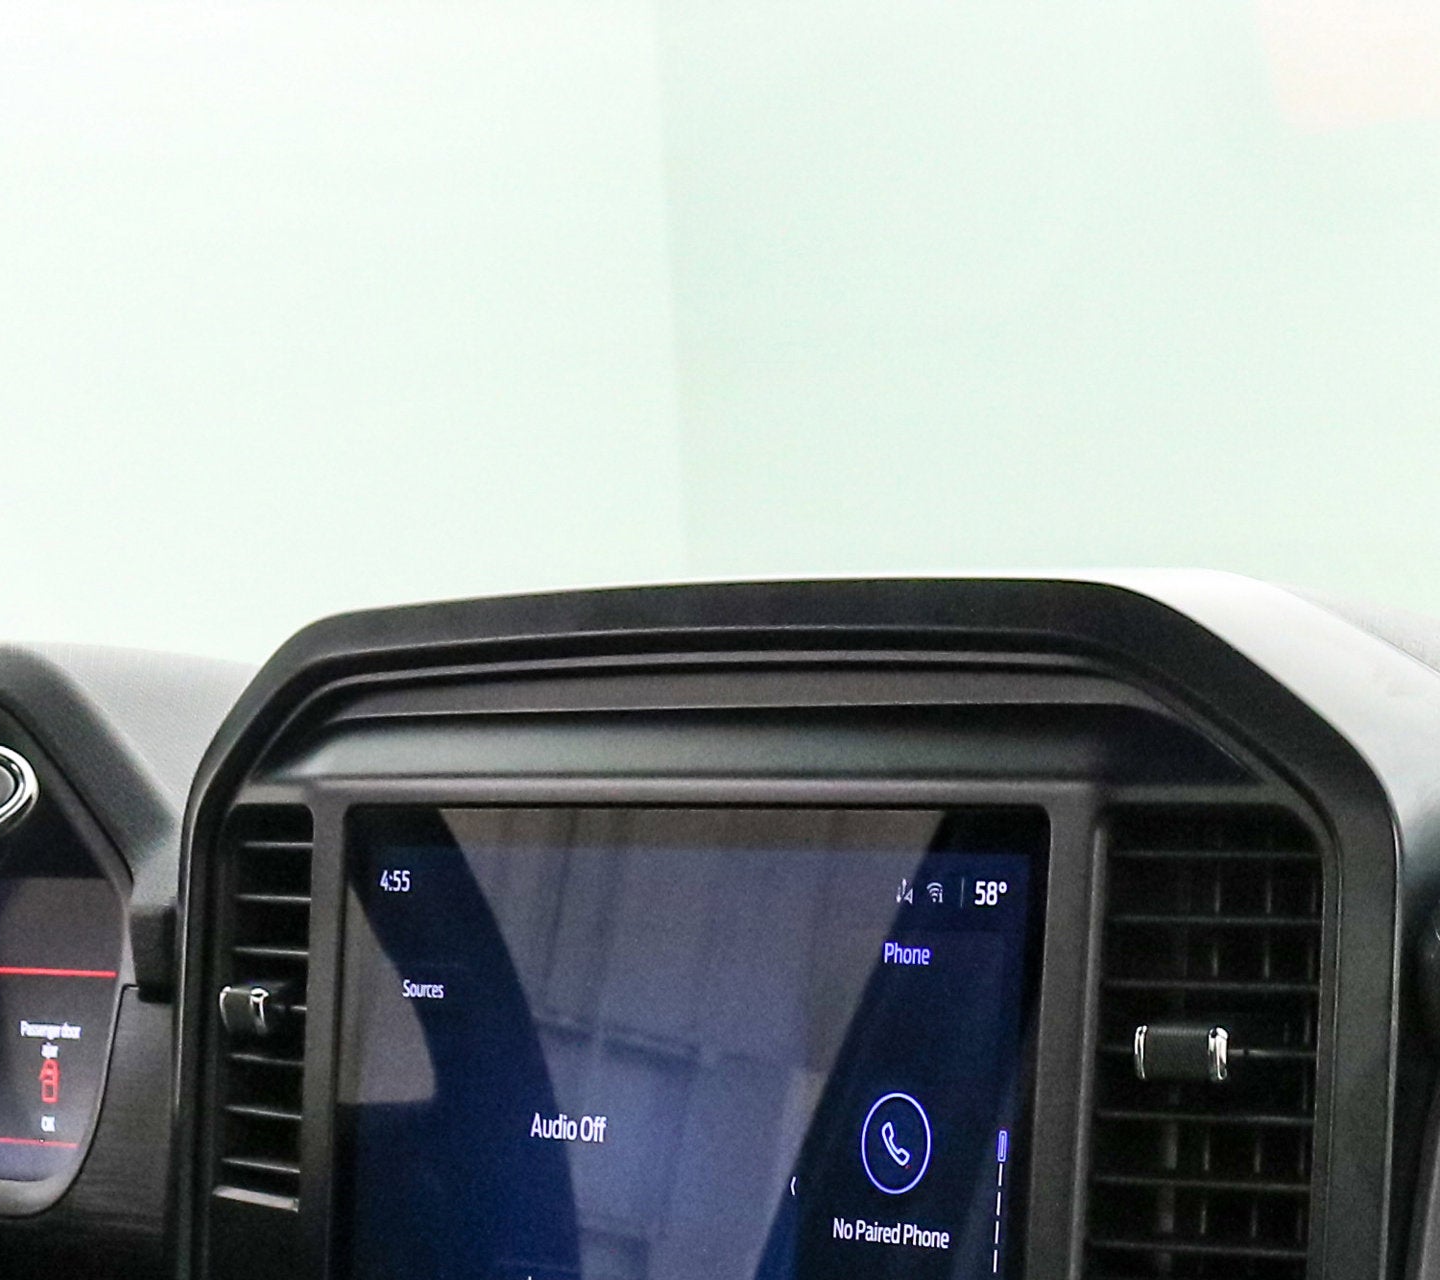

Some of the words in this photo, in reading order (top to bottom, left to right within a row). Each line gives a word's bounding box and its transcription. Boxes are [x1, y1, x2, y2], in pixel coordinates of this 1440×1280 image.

[379, 869, 411, 892] 4:55
[884, 942, 932, 965] Phone
[401, 979, 444, 999] Sources
[530, 1112, 578, 1141] Audio
[580, 1115, 607, 1143] Off
[832, 1217, 854, 1240] No
[856, 1219, 901, 1244] Paired
[902, 1223, 950, 1249] Phone
